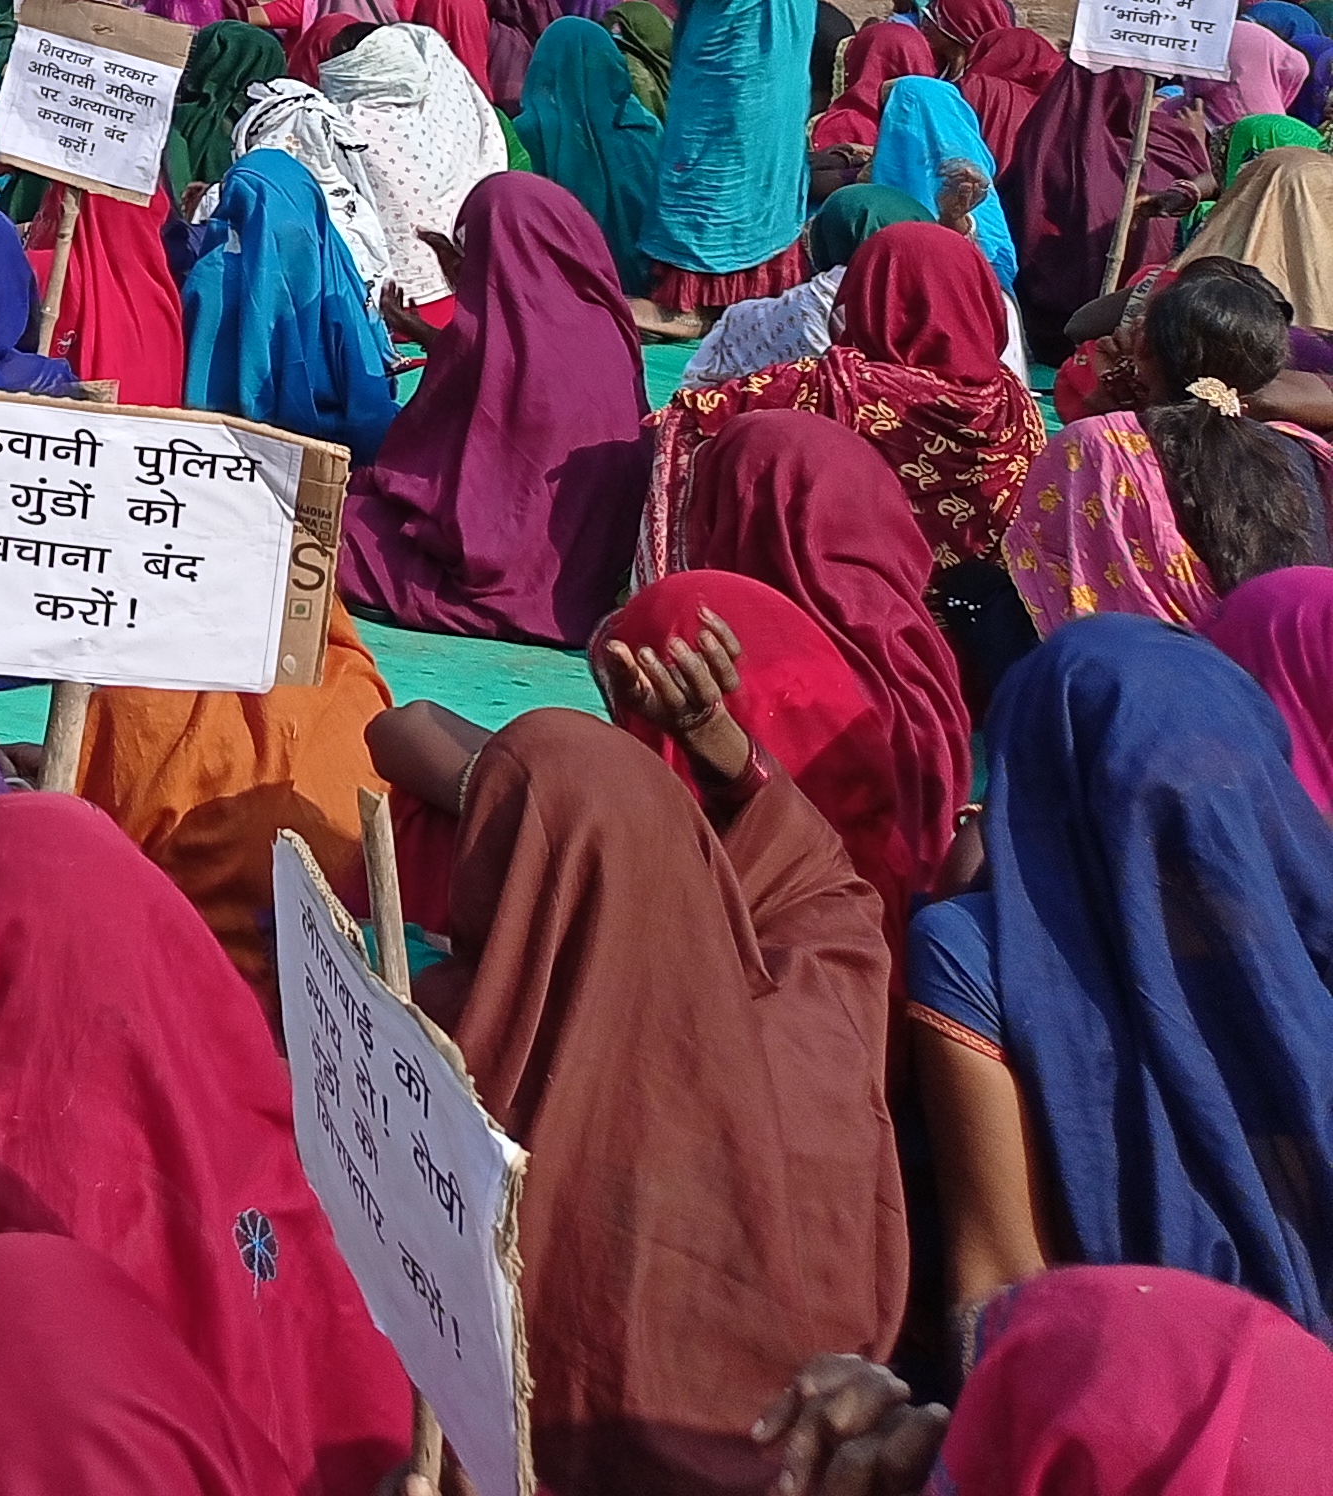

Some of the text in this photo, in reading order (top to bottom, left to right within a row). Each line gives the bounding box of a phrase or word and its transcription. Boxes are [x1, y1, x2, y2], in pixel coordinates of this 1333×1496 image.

[1189, 18, 1217, 35] पर
[27, 60, 156, 109] आदिवासी महिला
[36, 38, 159, 87] शिवराज सरकार
[37, 105, 129, 144] करवाना बंद
[39, 84, 137, 124] पर अत्याचार
[134, 438, 263, 488] पुलिस
[10, 476, 186, 529] गुंडों को
[142, 542, 205, 583] बंद
[299, 898, 432, 1120] लीलाबाई को
[304, 961, 343, 1062] न्याय
[410, 1129, 466, 1237] दोषी
[313, 1067, 386, 1246] गिरफ्तार
[352, 1107, 379, 1176] को
